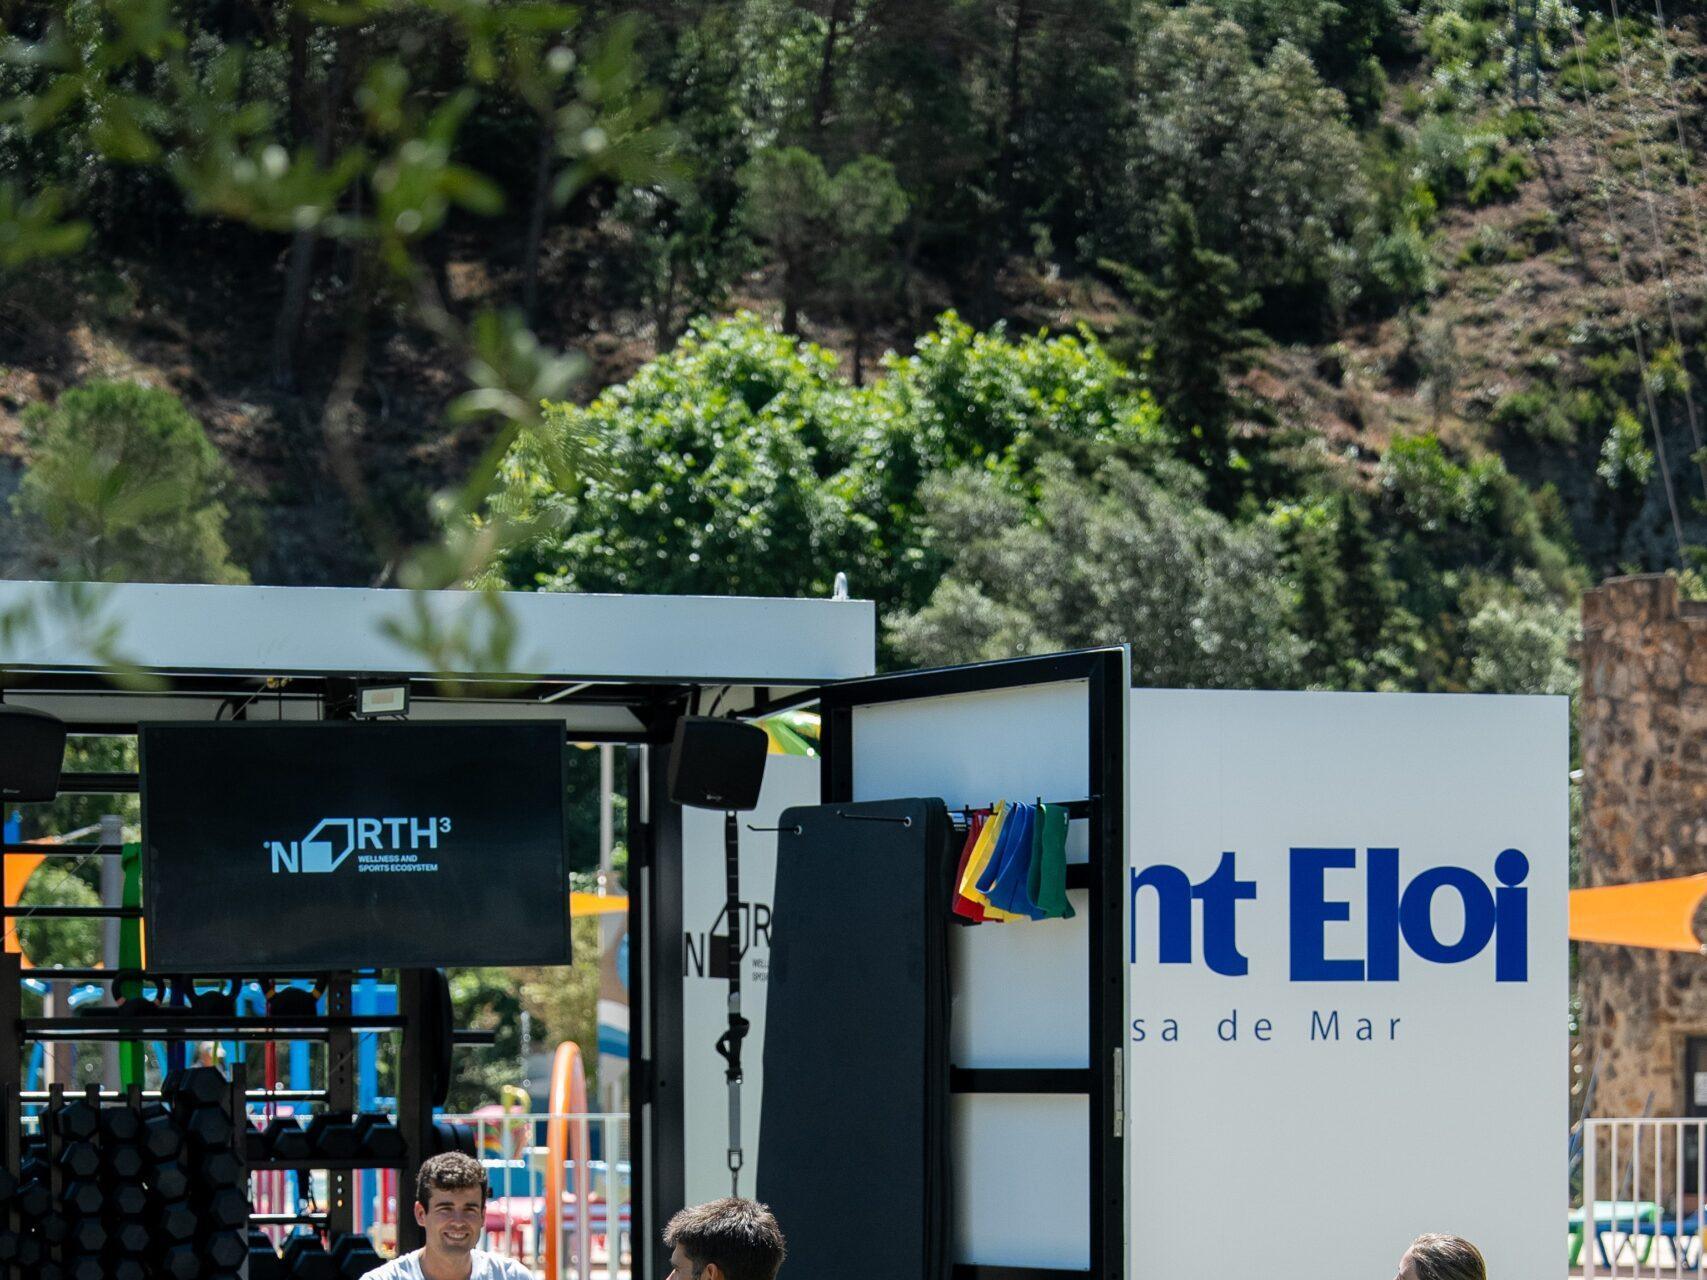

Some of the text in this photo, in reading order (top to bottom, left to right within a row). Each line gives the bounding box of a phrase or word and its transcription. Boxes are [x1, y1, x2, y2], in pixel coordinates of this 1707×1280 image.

[358, 854, 418, 863] WELLNESS AND
[358, 863, 438, 872] SPORTS ECOSYSTEM
[1289, 848, 1530, 982] Eloi
[1217, 1009, 1273, 1042] de
[1310, 1010, 1401, 1042] Mar
